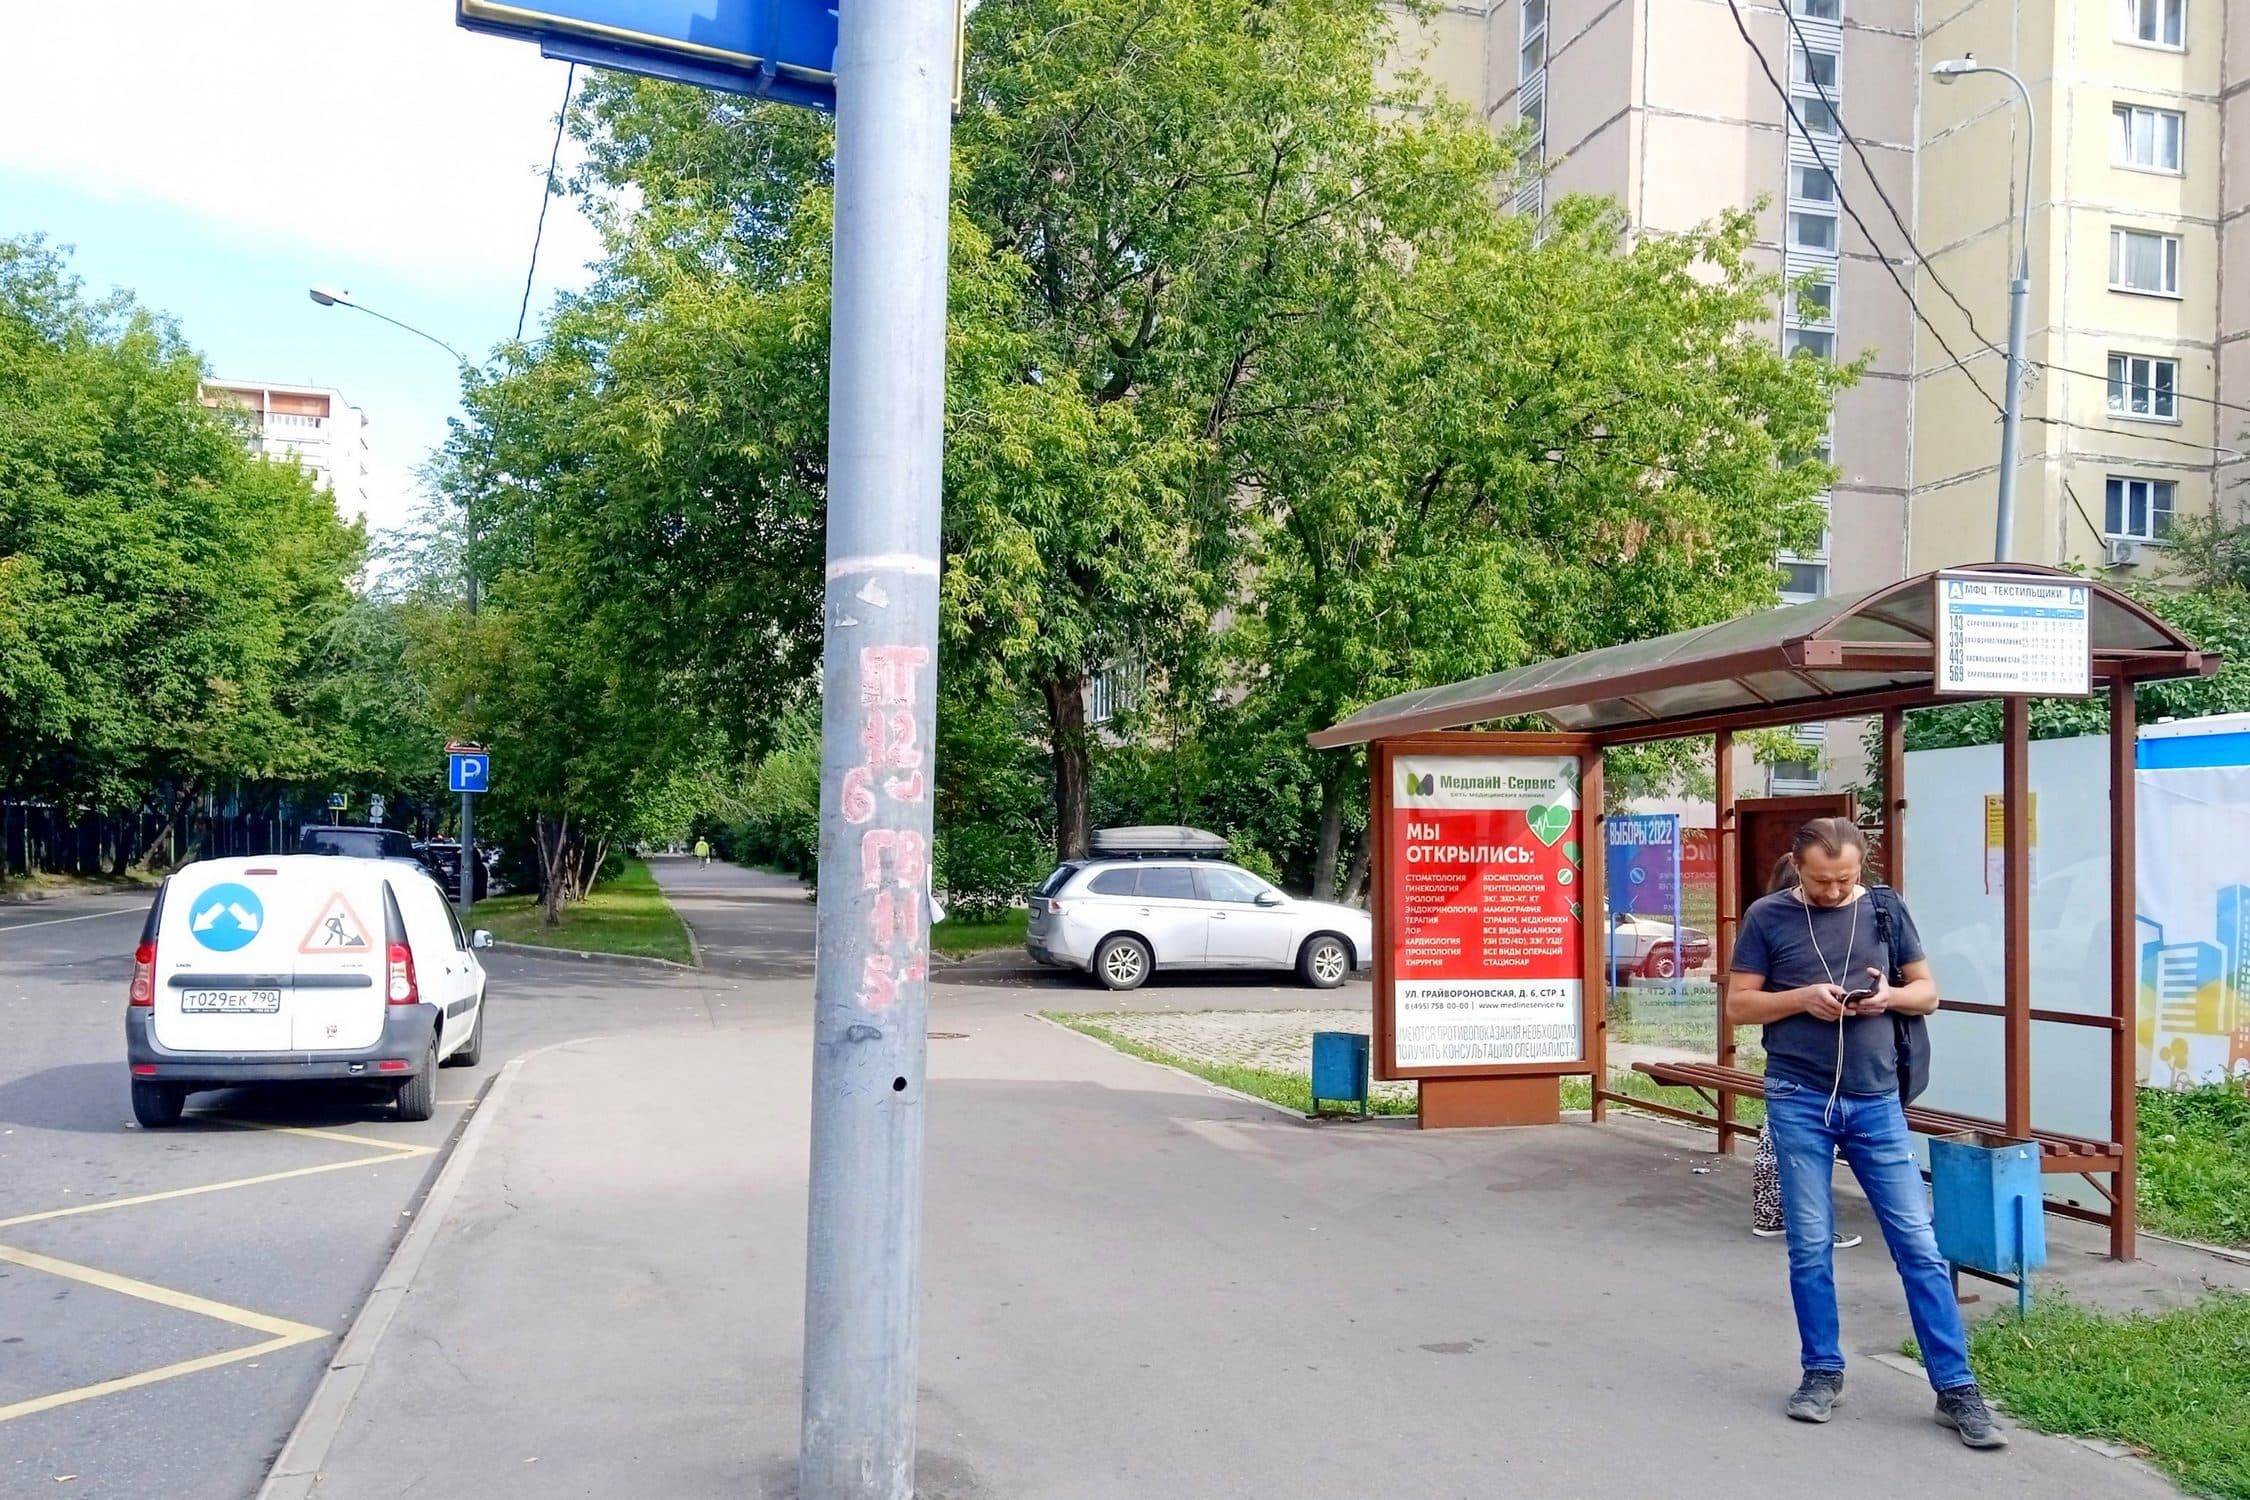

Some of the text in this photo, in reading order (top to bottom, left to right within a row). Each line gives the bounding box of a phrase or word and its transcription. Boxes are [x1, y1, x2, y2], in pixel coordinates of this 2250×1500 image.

[1965, 585, 1987, 596] МФЦ
[1949, 615, 1964, 630] 143
[1949, 632, 1964, 647] 334
[1949, 648, 1964, 664] 443
[1949, 665, 1964, 682] 569
[460, 758, 482, 787] P
[1406, 823, 1440, 841] МЫ
[1609, 819, 1673, 846] ВЫБОРЫ 2022
[1406, 845, 1535, 864] ОТКРЫЛИСЬ:
[1405, 874, 1466, 882] СТОМАТОЛОГИЯ
[1405, 895, 1445, 903] УРОЛОГИЯ
[1405, 916, 1439, 924] ТЕРАПИЯ
[1483, 916, 1569, 924] СПРАВКИ, МЕДКНИЖКИ
[1498, 927, 1521, 935] ВИДЫ
[1405, 937, 1461, 945] КАРДИОЛОГИЯ
[1483, 937, 1497, 945] УЗИ
[1546, 937, 1564, 945] УЗДГ
[1522, 947, 1563, 956] ОПЕРАЦИЙ
[1483, 958, 1530, 966] СТАЦИОНАР
[252, 992, 275, 1003] 790
[1421, 988, 1517, 998] ГРАЙВОРОНОВСКАЯ,
[1518, 989, 1528, 998] Д.
[1396, 1042, 1577, 1060] ПОЛУЧИТЬ КОНСУЛЬТАЦИЮ СПЕЦИАЛИСТА
